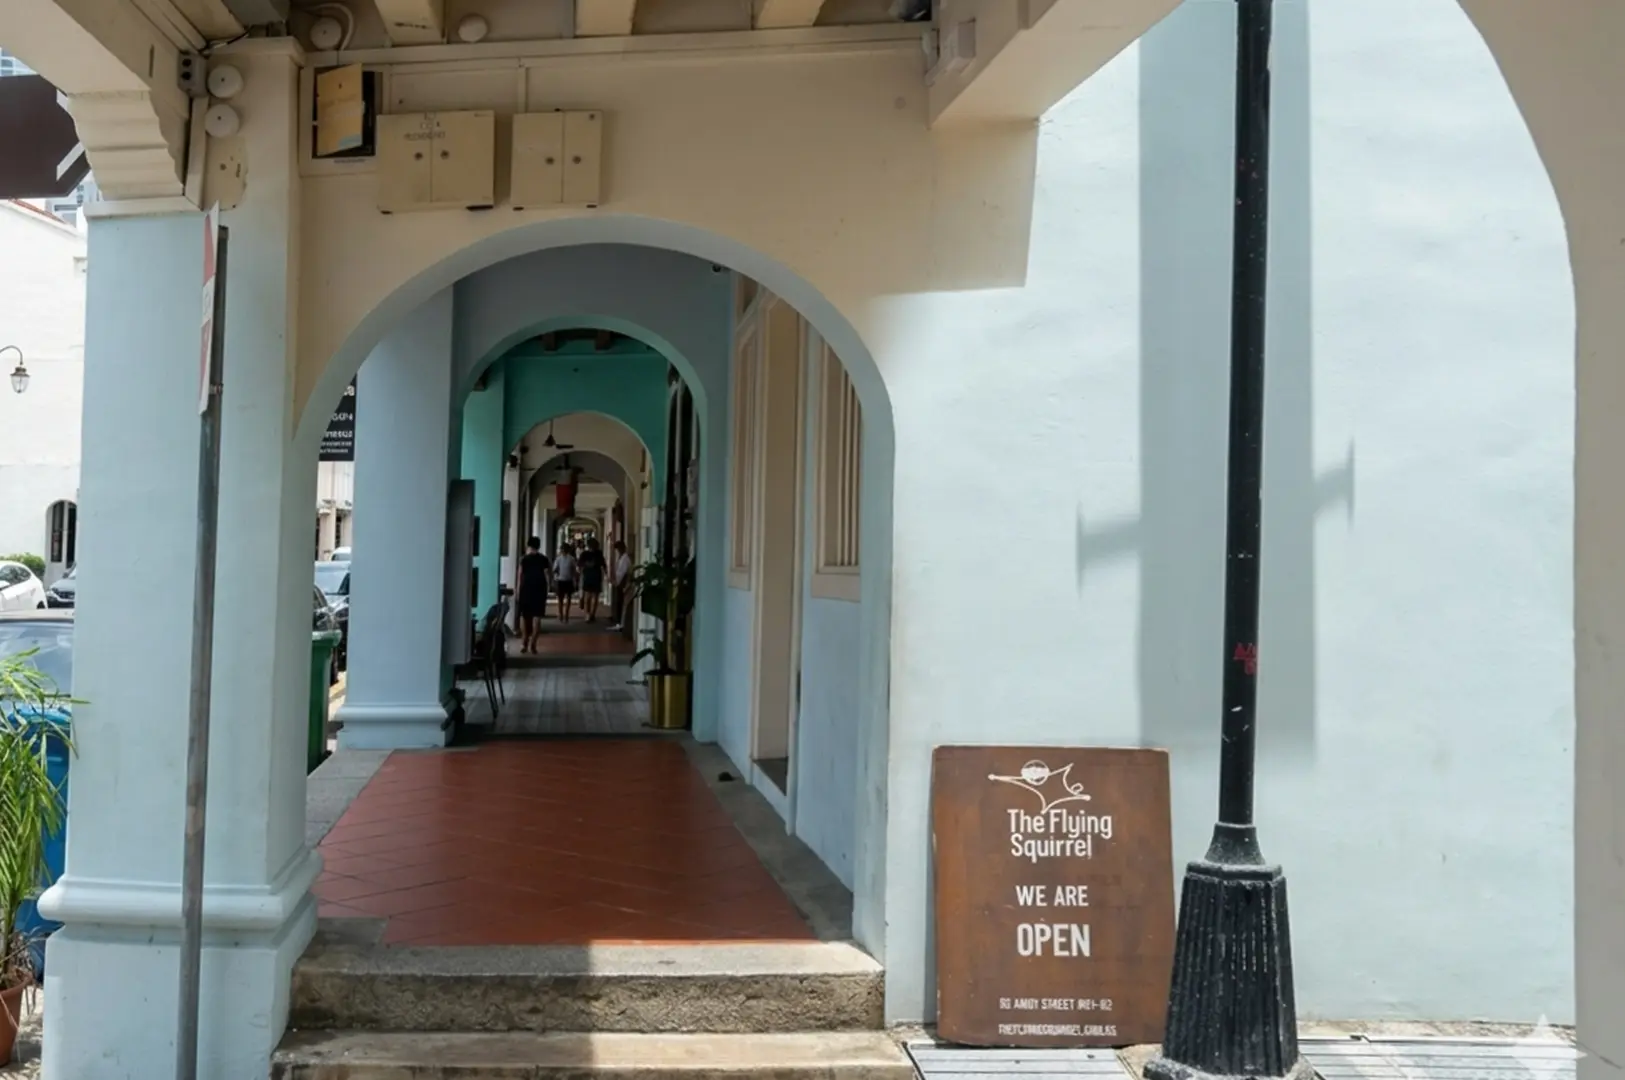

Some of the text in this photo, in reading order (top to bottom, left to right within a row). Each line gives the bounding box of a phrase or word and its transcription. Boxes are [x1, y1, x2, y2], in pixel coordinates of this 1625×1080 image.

[1007, 808, 1112, 839] The Flying
[1010, 833, 1092, 863] Squirrel
[1015, 885, 1089, 907] WE ARE
[1017, 923, 1091, 957] OPEN
[1040, 998, 1075, 1011] STREET
